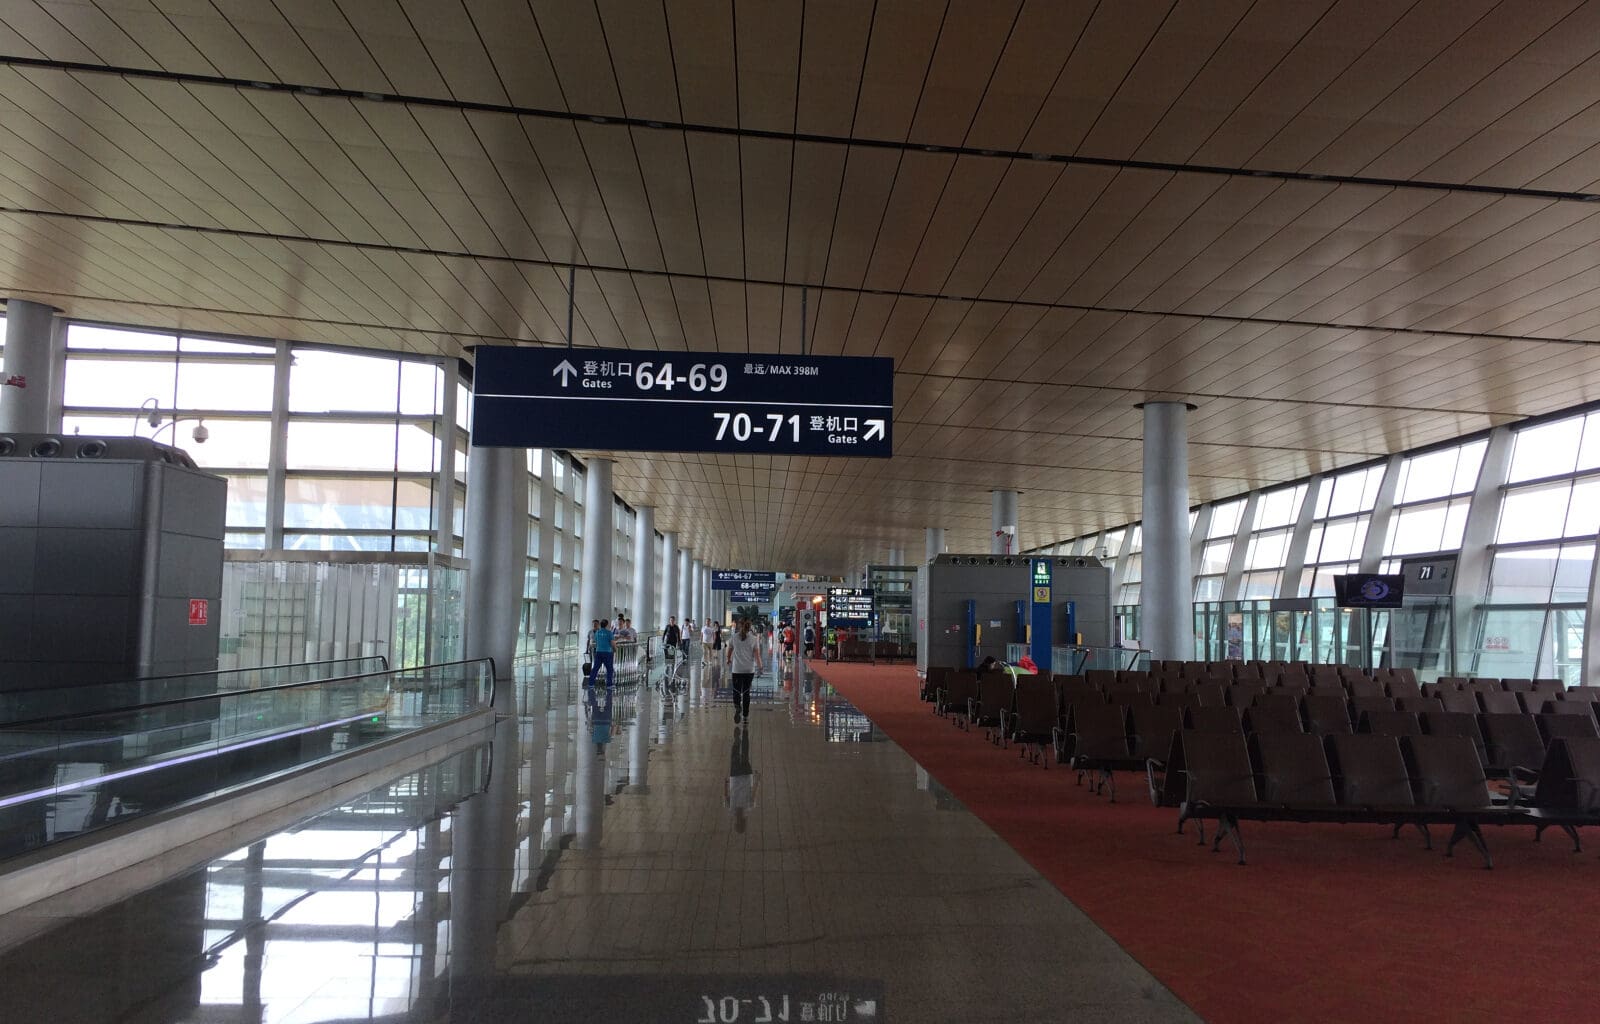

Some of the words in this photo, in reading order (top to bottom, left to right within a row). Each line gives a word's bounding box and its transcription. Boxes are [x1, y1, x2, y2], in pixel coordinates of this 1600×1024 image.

[583, 360, 632, 377] 登机口
[635, 361, 728, 393] 64-69
[793, 366, 819, 376] 398M
[582, 378, 612, 389] Gates
[713, 412, 801, 443] 70-71
[809, 415, 858, 432] 登机口
[828, 433, 858, 444] Gates
[1420, 566, 1431, 579] 71
[740, 582, 760, 590] 68-69
[855, 588, 862, 596] 71
